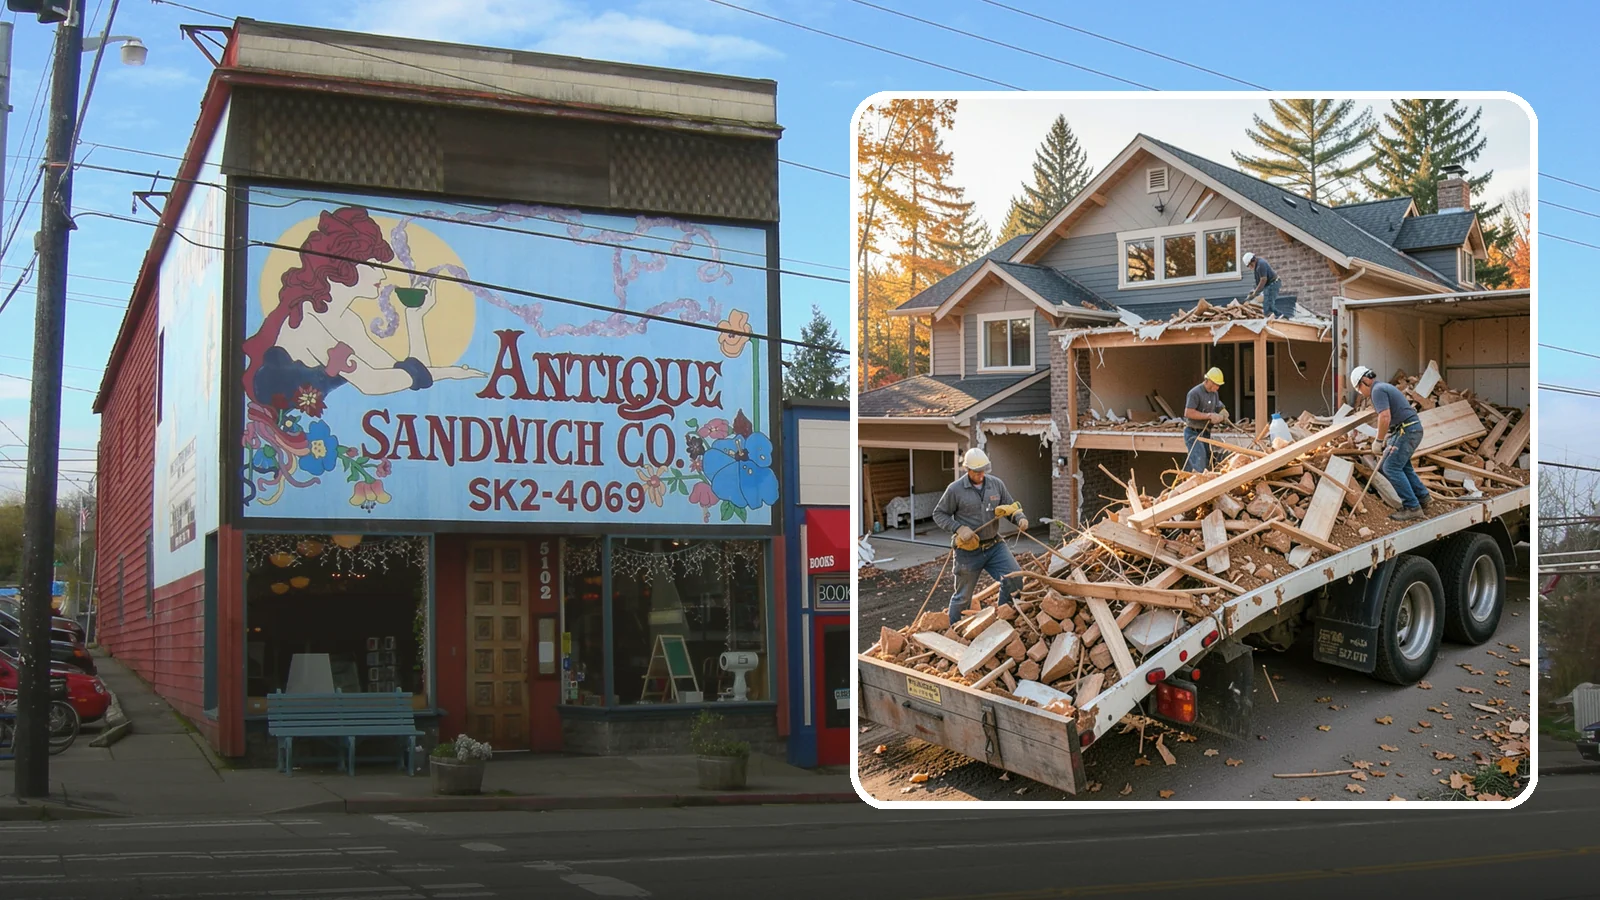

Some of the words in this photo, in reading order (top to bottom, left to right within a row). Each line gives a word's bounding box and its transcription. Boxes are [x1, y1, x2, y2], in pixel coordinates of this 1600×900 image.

[475, 329, 723, 421] ANTIQUE
[361, 408, 605, 467] SANDWICH
[617, 422, 685, 469] CO.
[468, 477, 646, 513] SK2-4069
[539, 541, 552, 600] 5102
[809, 556, 834, 569] BOOKS
